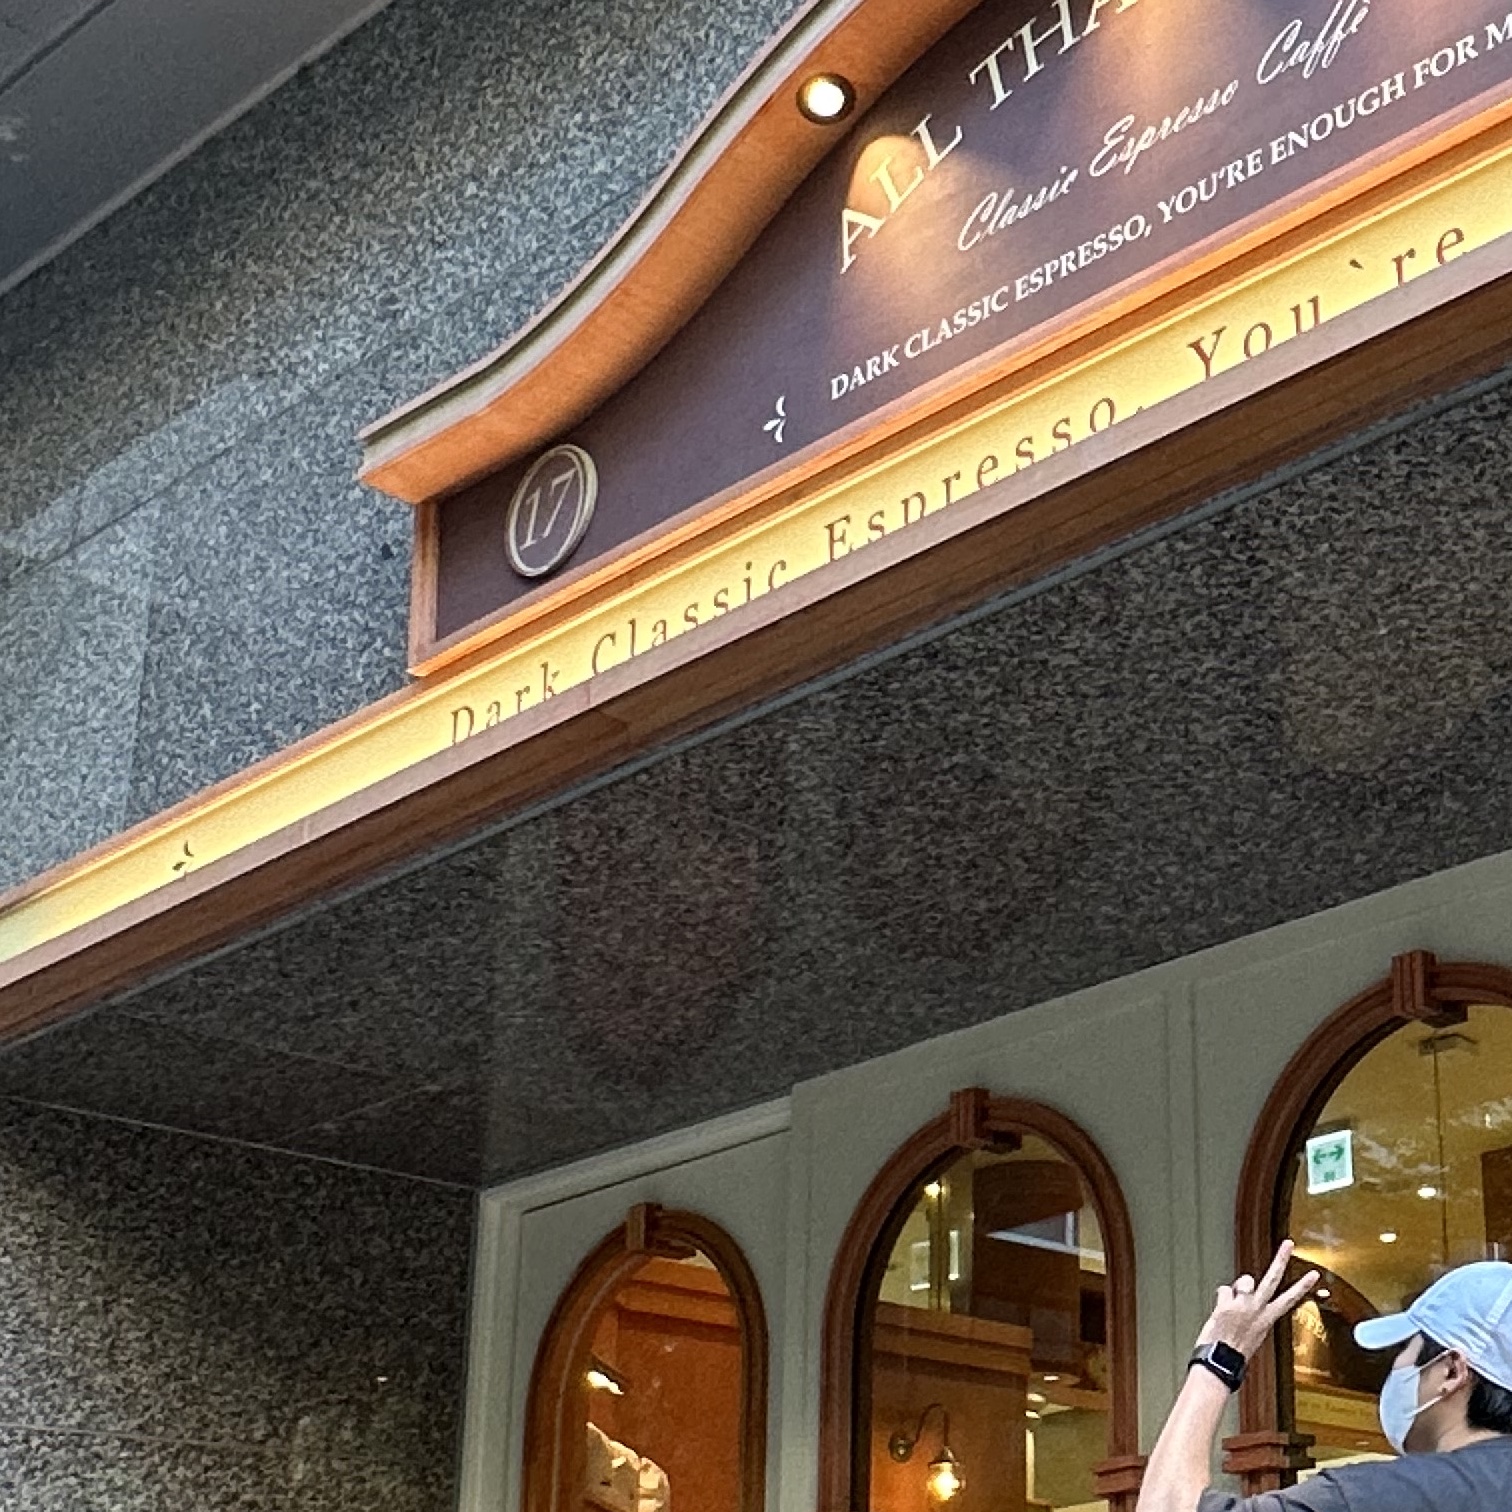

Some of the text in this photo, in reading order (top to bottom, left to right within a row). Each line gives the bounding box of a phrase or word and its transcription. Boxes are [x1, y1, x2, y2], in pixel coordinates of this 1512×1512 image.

[831, 344, 900, 400] DARK
[903, 285, 1009, 360] CLASSIC
[1015, 213, 1153, 302] ESPRESSO,
[1156, 147, 1264, 224] YOU'RE
[1270, 72, 1406, 167] ENOUGH
[1413, 34, 1479, 90] FOR
[840, 114, 963, 274] ALL
[957, 166, 1079, 251] Classic
[1089, 79, 1239, 177] Espresso
[519, 466, 578, 551] 17
[451, 661, 560, 744] Dark
[591, 559, 787, 677] Classic
